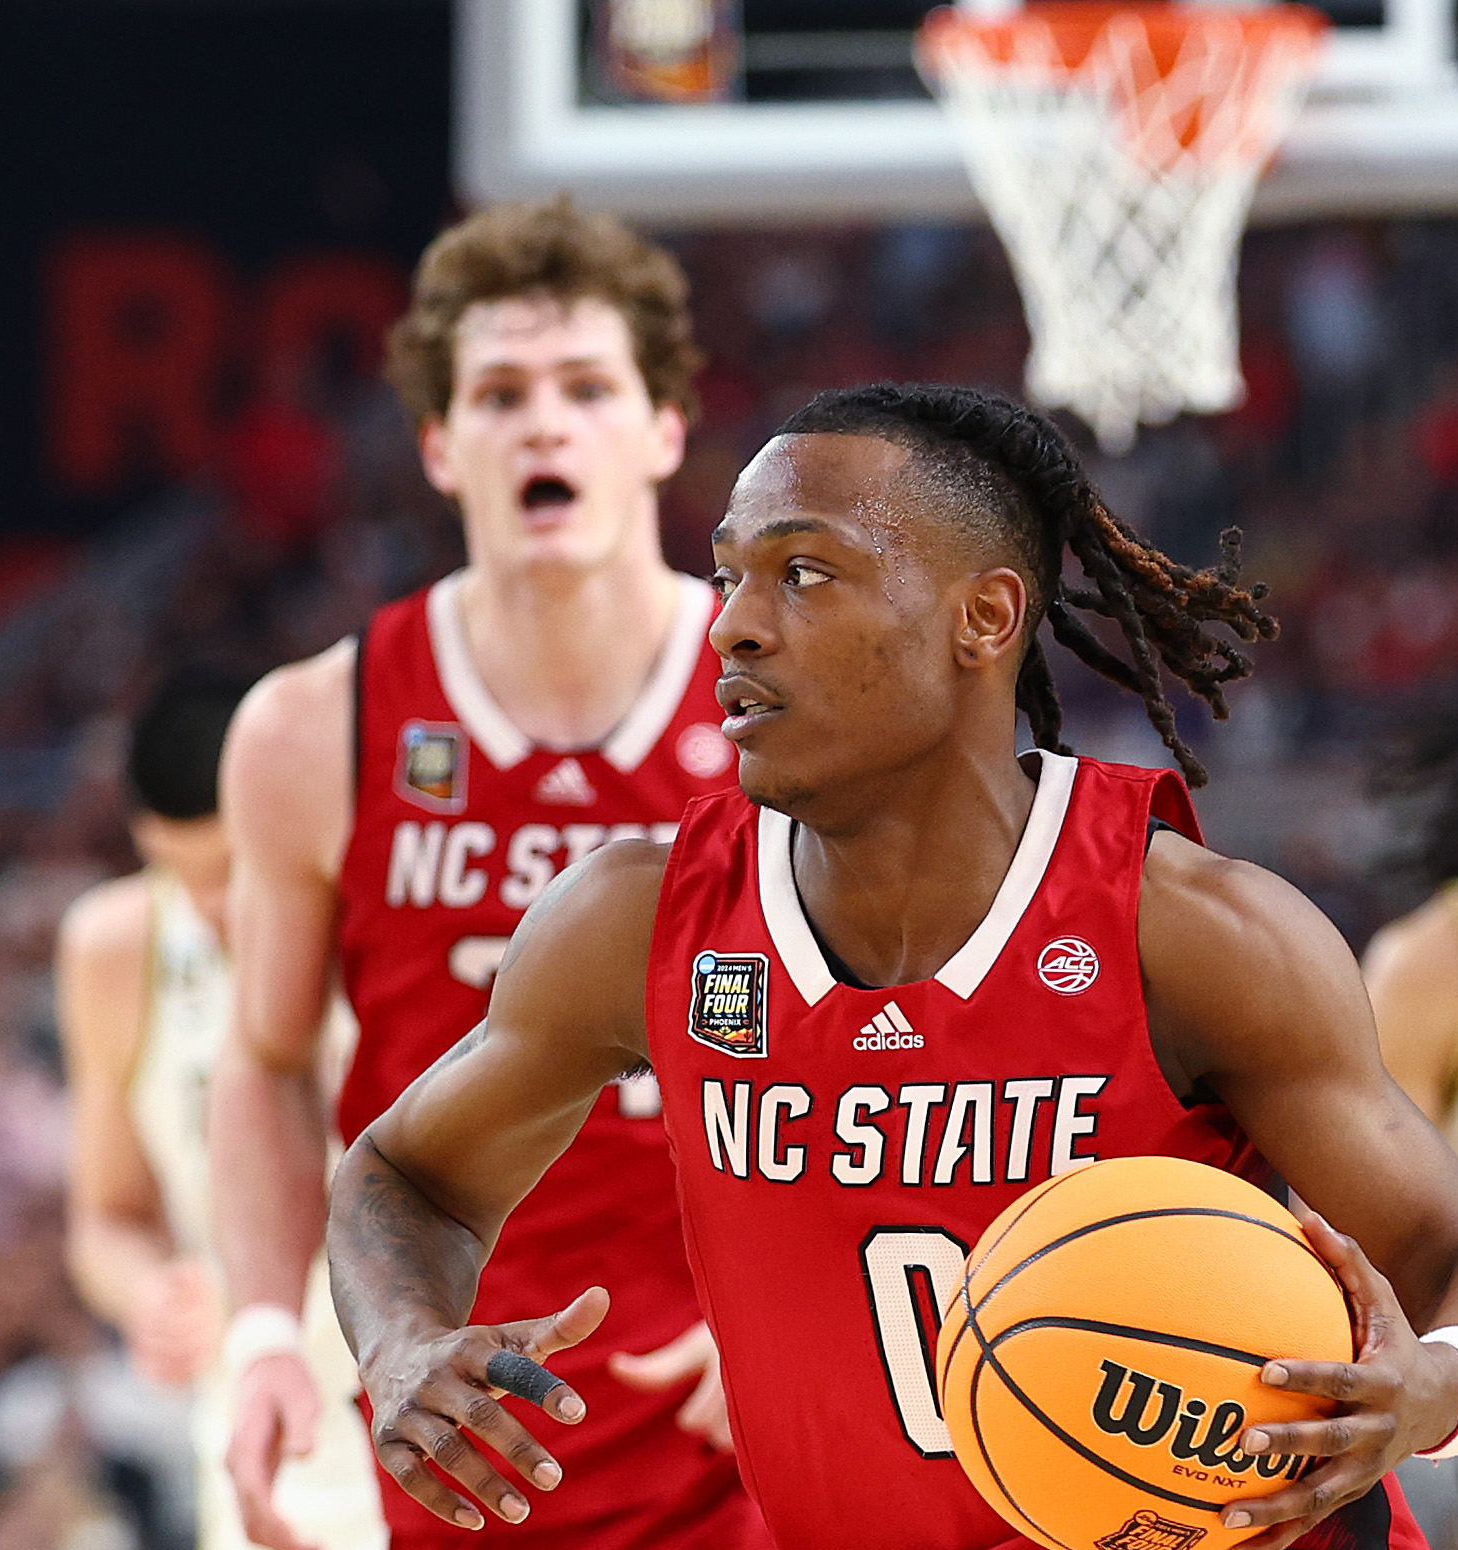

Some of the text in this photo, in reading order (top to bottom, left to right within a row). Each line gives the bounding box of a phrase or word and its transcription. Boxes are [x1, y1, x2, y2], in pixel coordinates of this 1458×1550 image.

[385, 820, 495, 909] NC
[1045, 957, 1095, 969] ACC
[704, 974, 749, 993] FINAL
[703, 994, 749, 1013] FOUR
[853, 1032, 924, 1050] adidas
[702, 1074, 1113, 1187] NC STATE
[858, 1225, 970, 1459] 0
[1172, 1465, 1246, 1488] EVO NXT
[1129, 1526, 1185, 1548] FINAL
